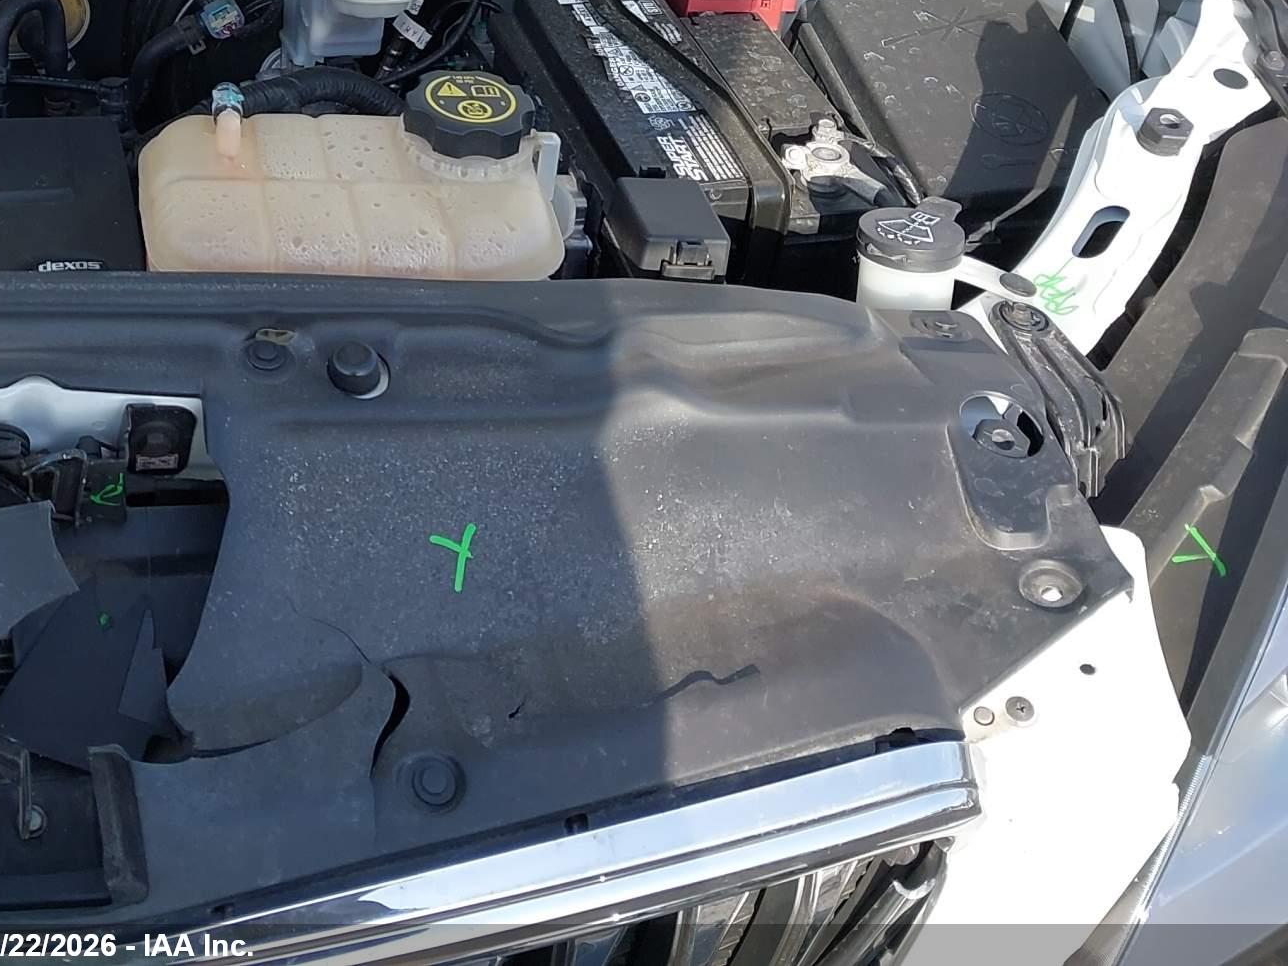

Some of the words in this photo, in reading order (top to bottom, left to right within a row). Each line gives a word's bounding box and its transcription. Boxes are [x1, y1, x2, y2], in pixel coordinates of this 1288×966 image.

[656, 136, 686, 176] SUPER
[667, 135, 709, 181] START
[37, 260, 103, 273] dexos
